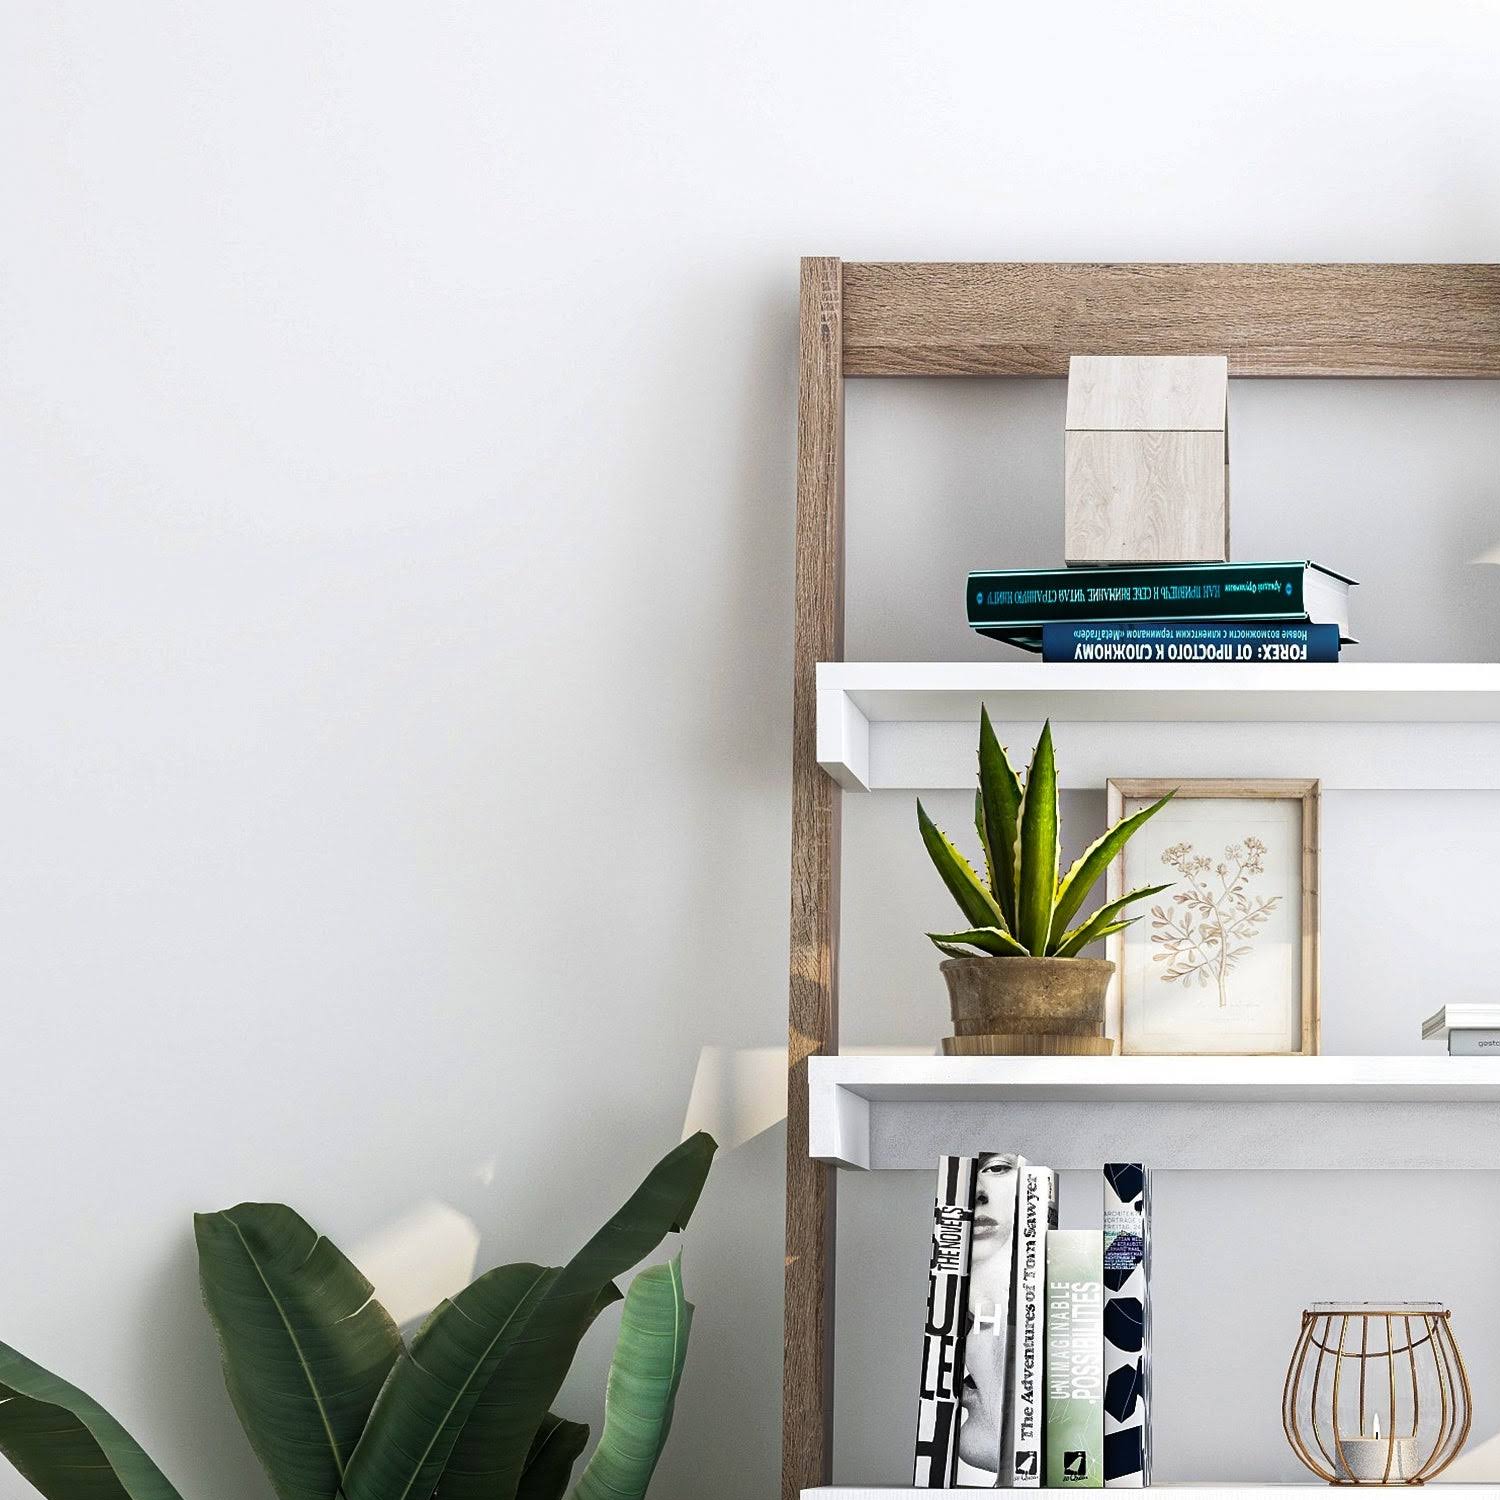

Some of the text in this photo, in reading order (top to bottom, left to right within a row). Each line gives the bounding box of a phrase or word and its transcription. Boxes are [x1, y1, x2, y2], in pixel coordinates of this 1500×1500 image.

[1058, 589, 1086, 602] ЧИТАЯ
[1087, 587, 1131, 602] ВНИМАНИЕ
[1073, 627, 1307, 641] Новые возможности с клиентским терминалом «MetaTrader»
[1074, 642, 1307, 660] FOREX: ОТ ПРОСТОГО К СЛОЖНОМУ
[937, 1206, 964, 1271] THE NOVELS
[1020, 1173, 1039, 1441] The Adventures of Tom Sawyer
[1050, 1281, 1071, 1400] UNIMAGINABLE
[1071, 1281, 1101, 1400] POSSIBILITIES
